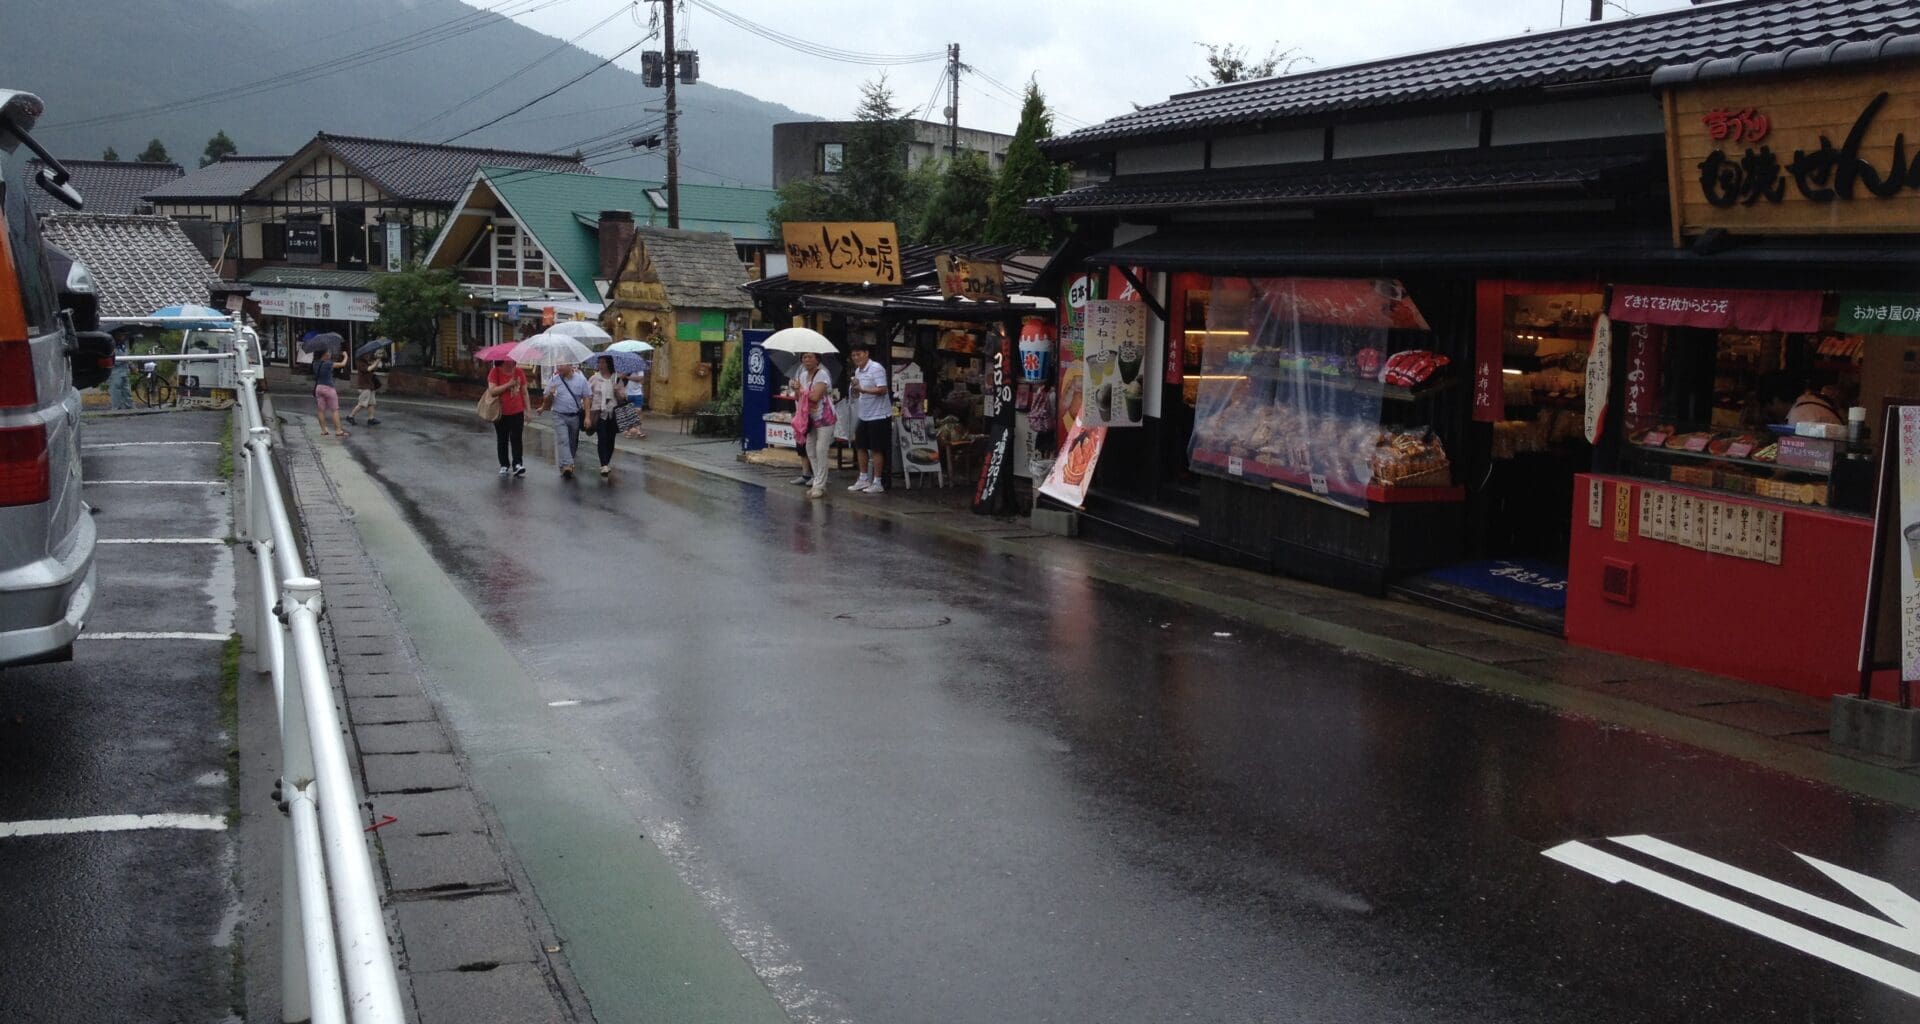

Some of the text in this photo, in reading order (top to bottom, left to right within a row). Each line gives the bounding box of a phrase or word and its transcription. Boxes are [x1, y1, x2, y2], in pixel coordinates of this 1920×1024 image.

[747, 374, 766, 386] BOSS
[1476, 360, 1490, 408] 湯布院
[1617, 486, 1629, 527] わさびのり
